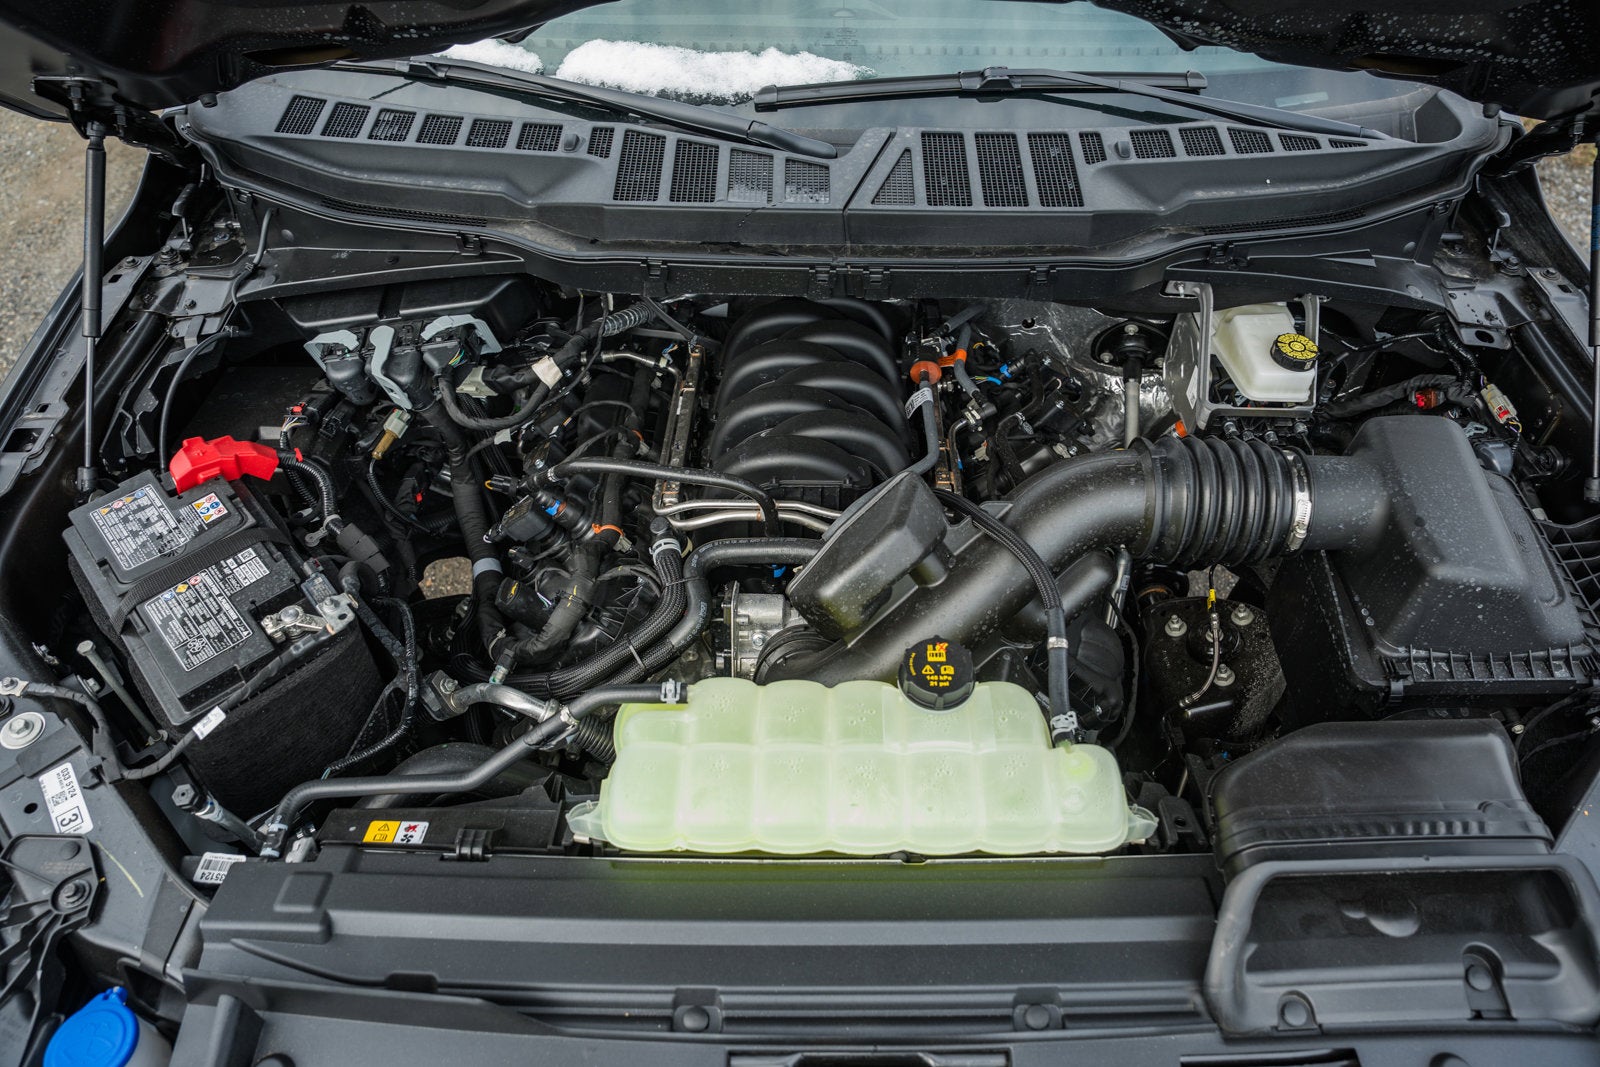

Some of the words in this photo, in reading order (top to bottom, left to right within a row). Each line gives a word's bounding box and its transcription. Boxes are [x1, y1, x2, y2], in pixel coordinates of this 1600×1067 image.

[61, 767, 71, 781] 033
[65, 781, 77, 798] 5124
[60, 813, 79, 827] 3
